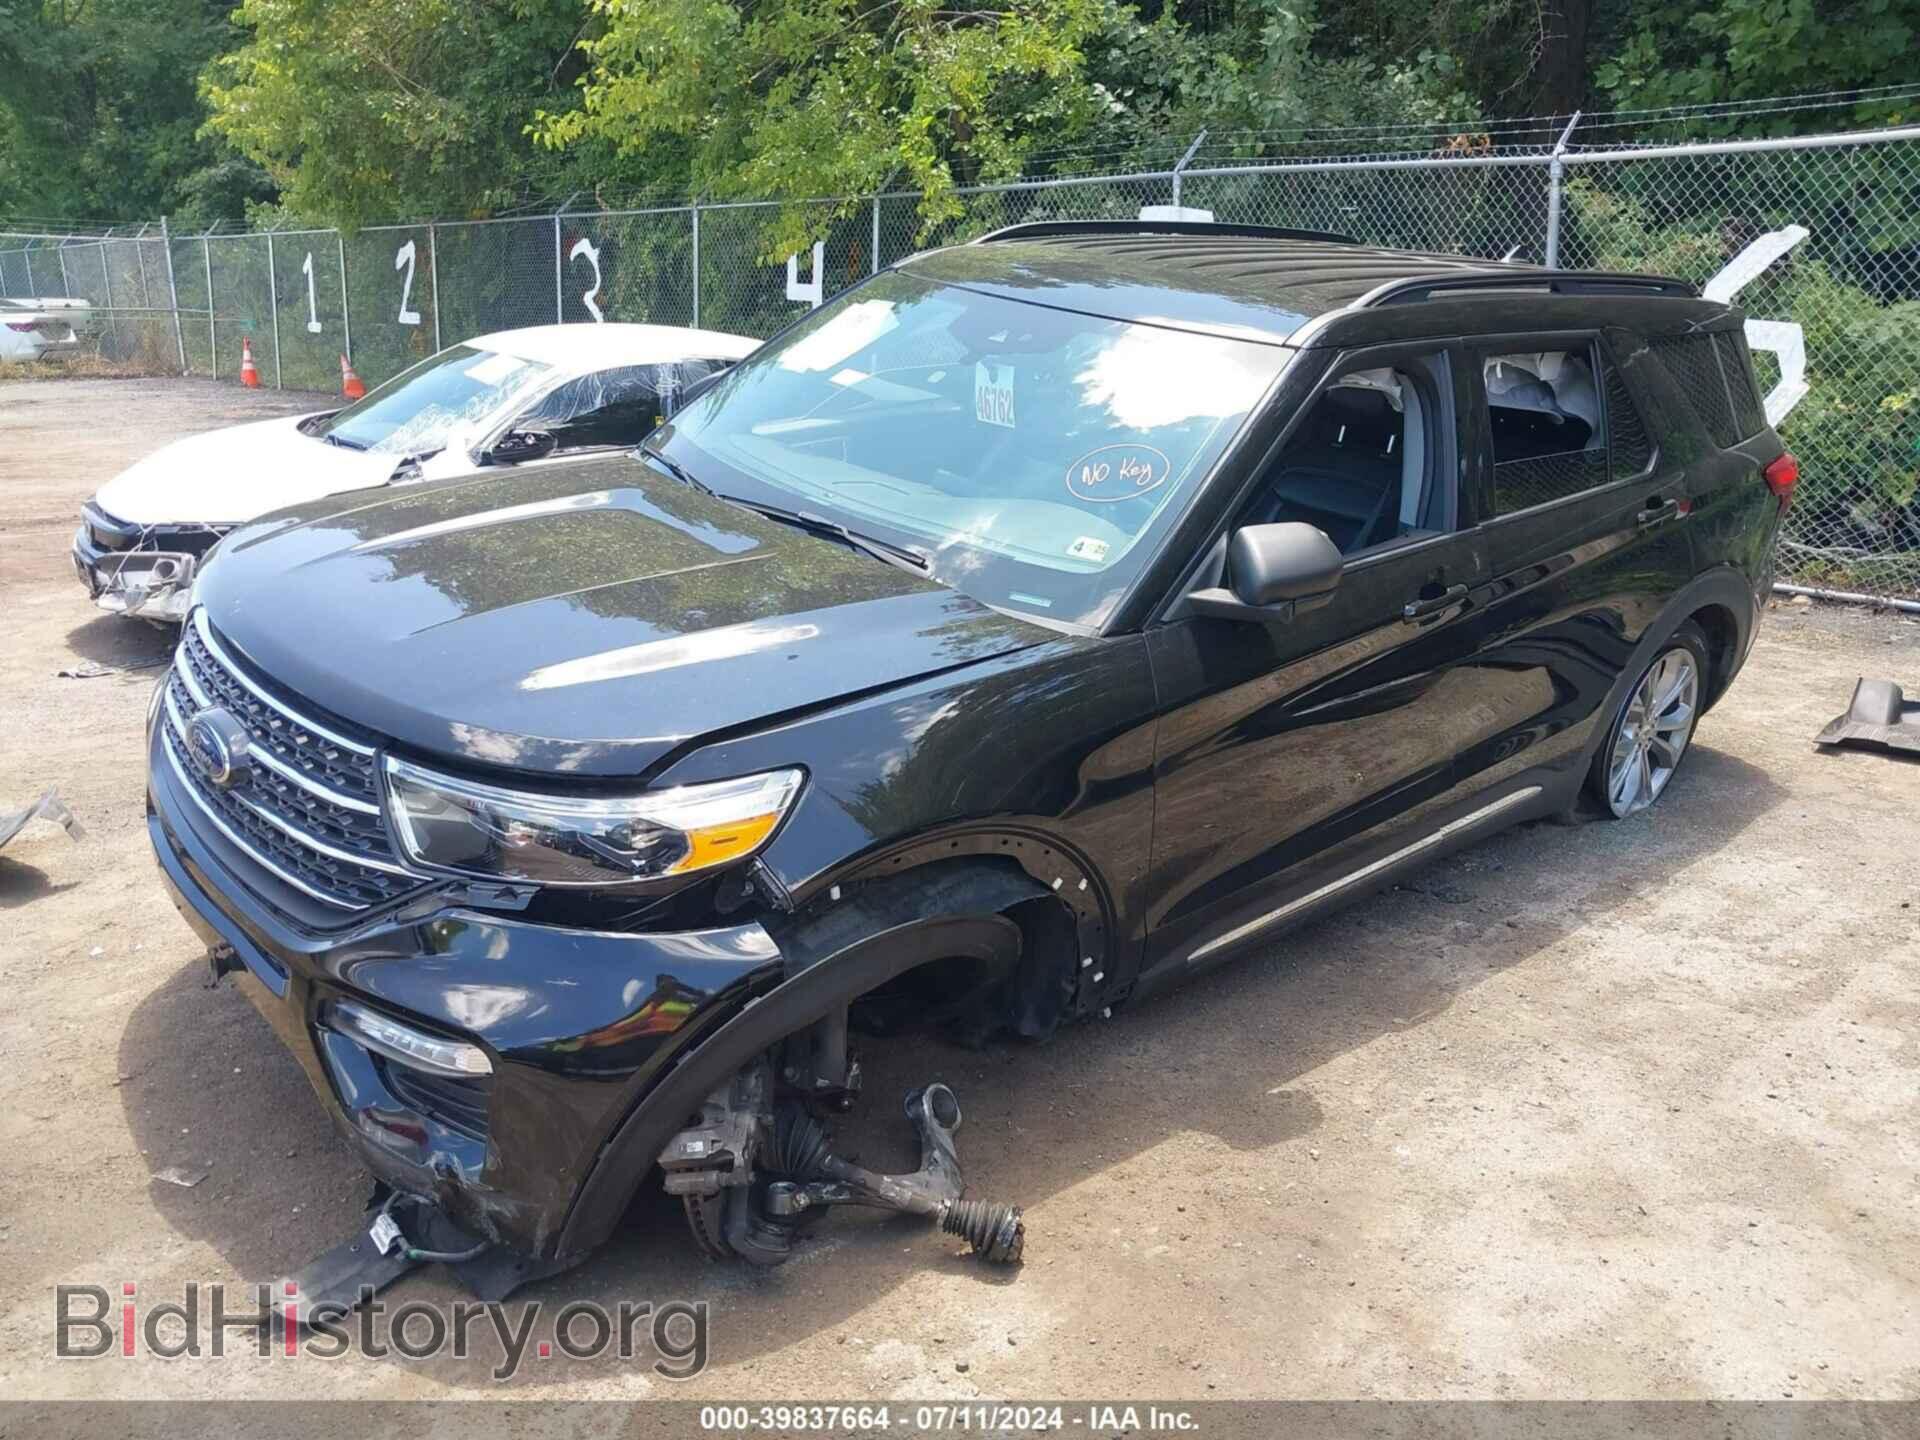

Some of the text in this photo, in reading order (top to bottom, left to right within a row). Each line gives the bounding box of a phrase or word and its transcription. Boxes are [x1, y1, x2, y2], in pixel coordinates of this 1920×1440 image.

[302, 251, 322, 333] 1
[395, 239, 422, 325] 2
[786, 241, 825, 309] 4
